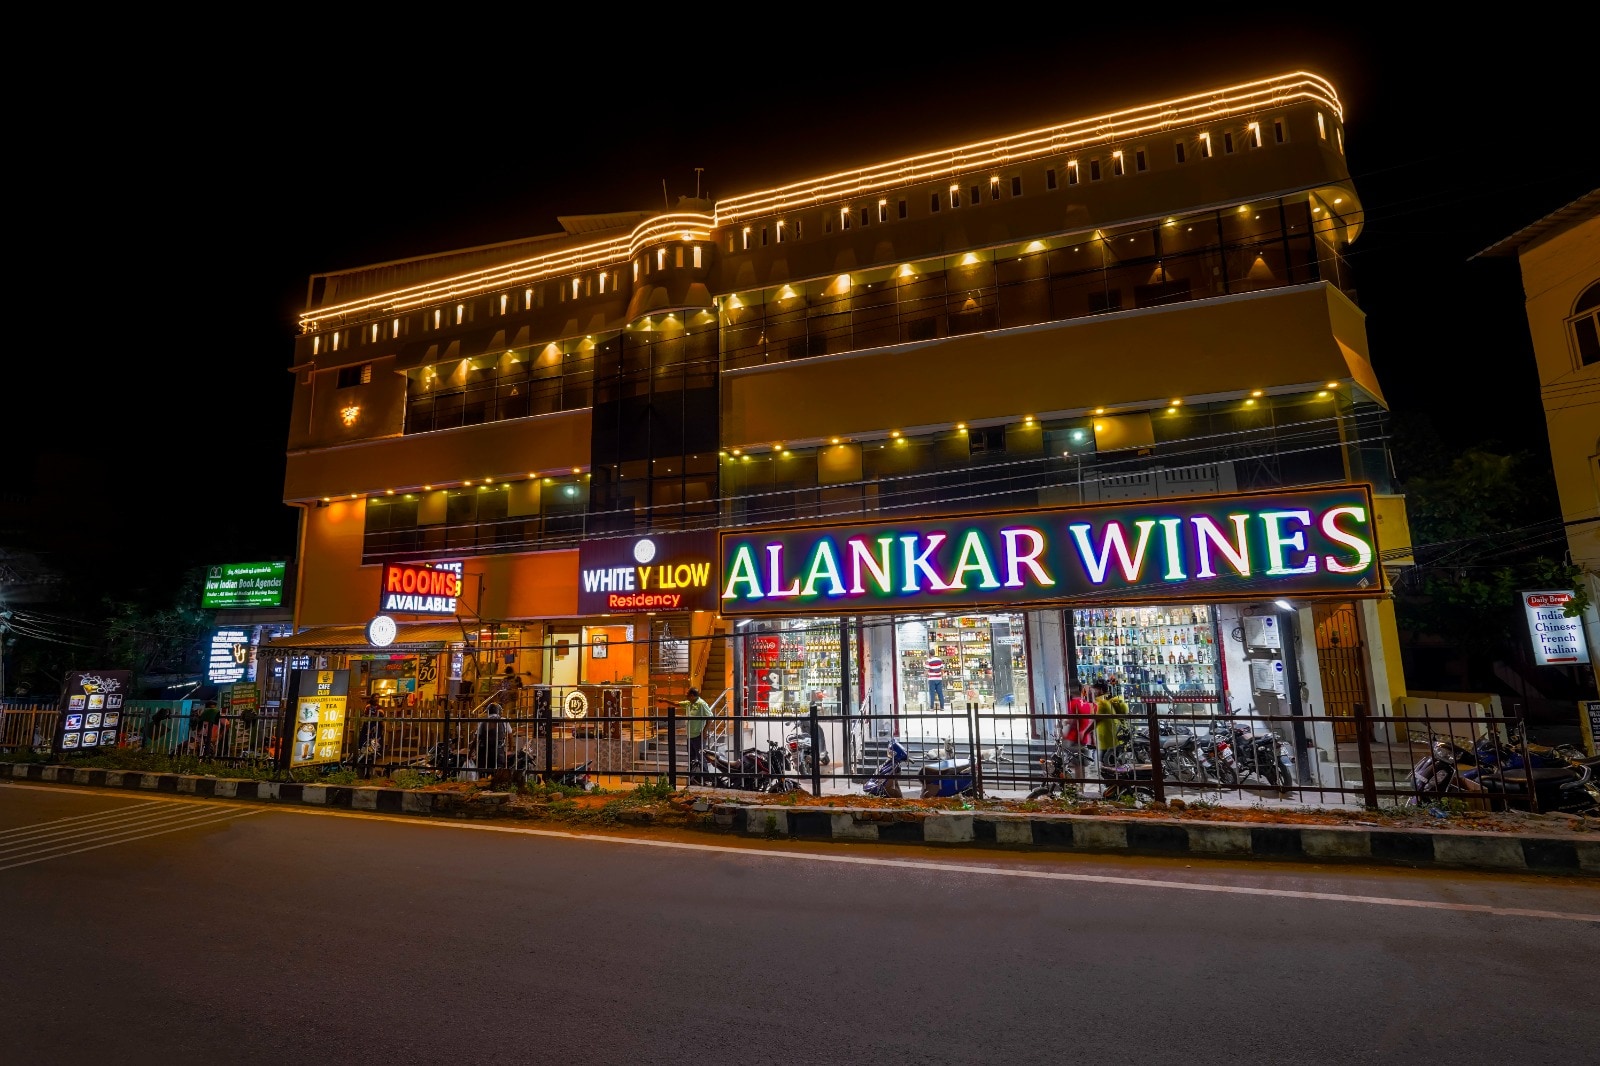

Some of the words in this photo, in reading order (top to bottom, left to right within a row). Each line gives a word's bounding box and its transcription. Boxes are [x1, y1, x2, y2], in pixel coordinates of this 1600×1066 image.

[721, 528, 1055, 600] ALANKAR
[1069, 506, 1374, 584] WINES
[206, 580, 219, 590] New
[220, 579, 238, 589] Indian
[239, 578, 254, 588] Book
[255, 577, 282, 589] Agencies
[388, 566, 456, 597] ROOMS
[583, 567, 635, 592] WHITE
[386, 595, 457, 612] AVAILABLE
[609, 593, 681, 607] Residency
[1530, 596, 1548, 604] Daily
[1549, 595, 1569, 603] Bread
[1536, 611, 1564, 621] India
[1535, 622, 1577, 632] Chinese
[1540, 632, 1576, 643] French
[1543, 645, 1578, 655] Italian
[324, 710, 343, 721] 10/-
[322, 728, 342, 740] 20/-
[319, 746, 340, 758] 45/-
